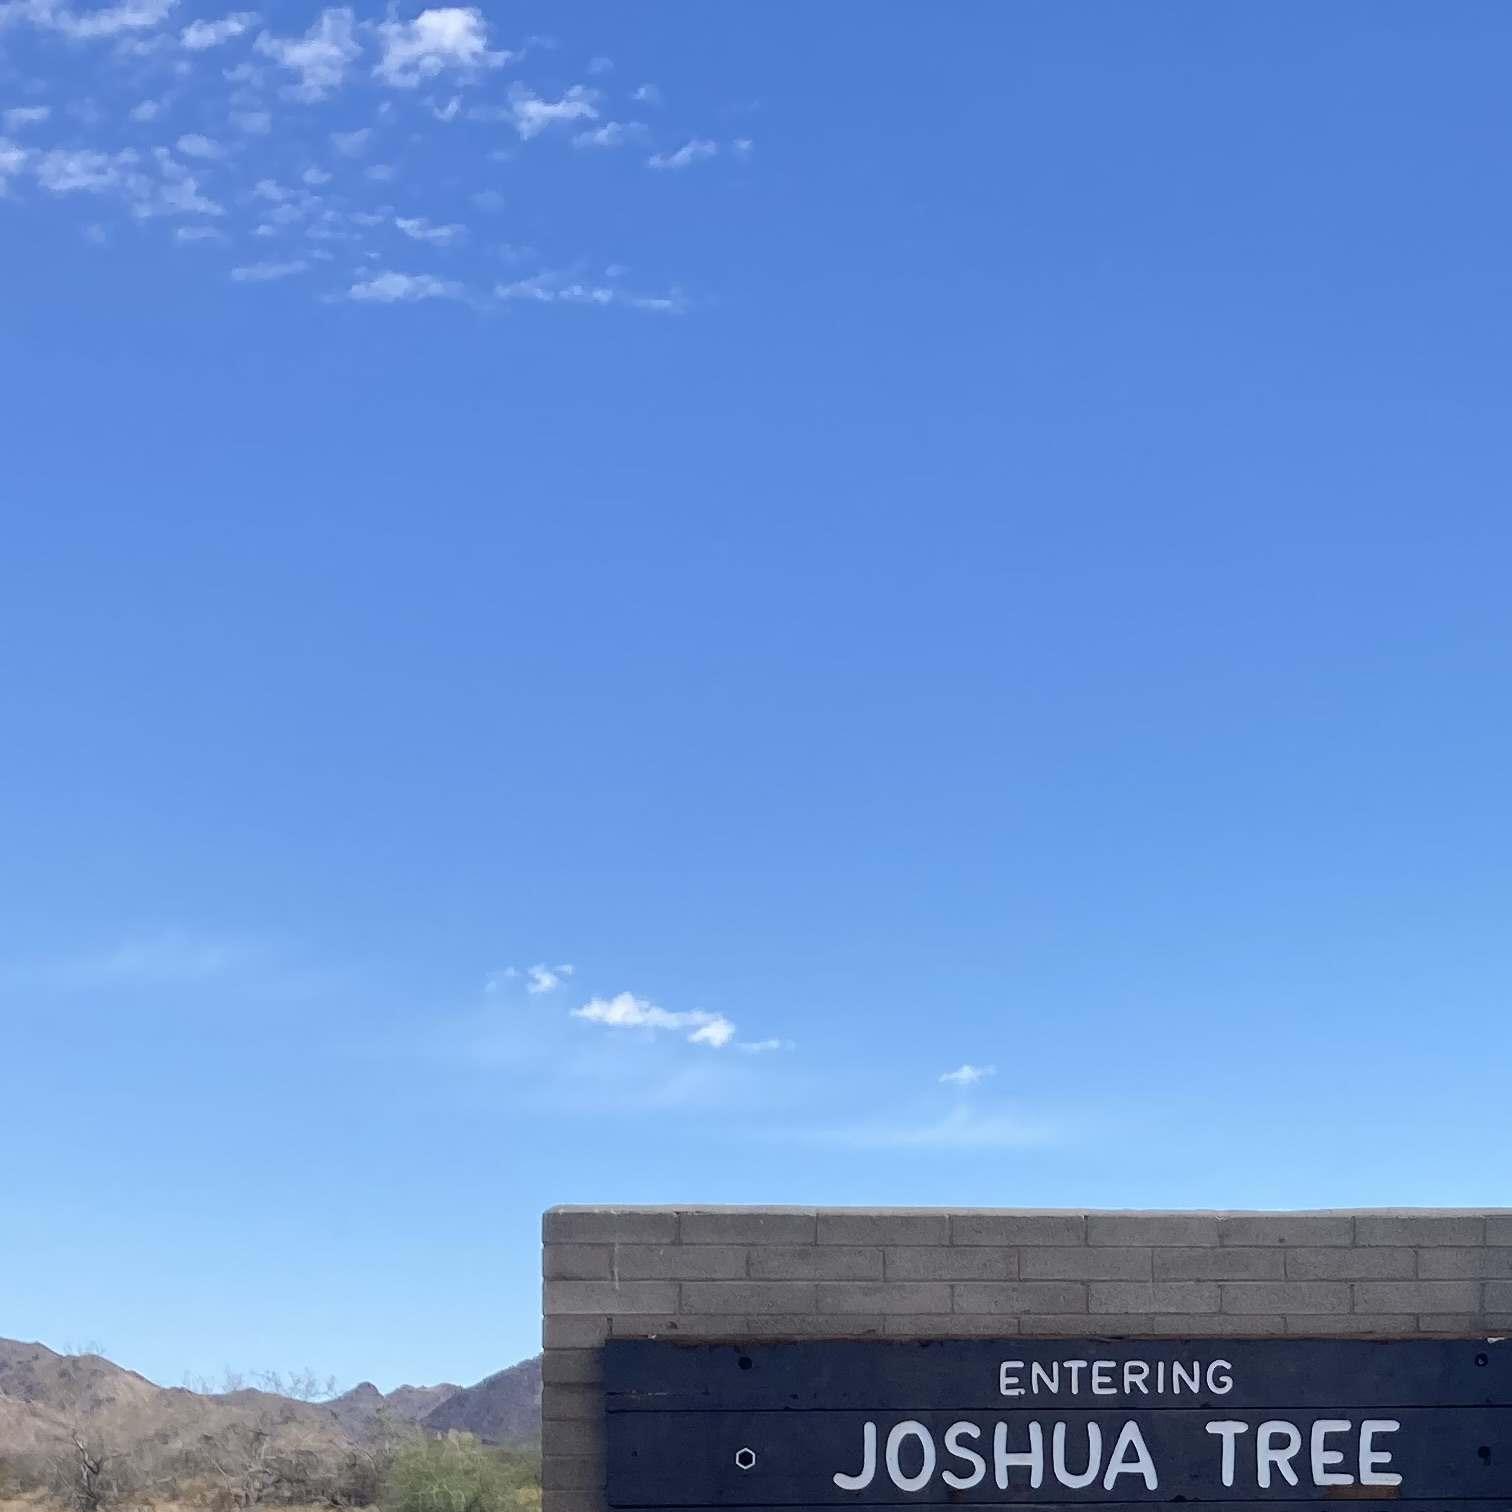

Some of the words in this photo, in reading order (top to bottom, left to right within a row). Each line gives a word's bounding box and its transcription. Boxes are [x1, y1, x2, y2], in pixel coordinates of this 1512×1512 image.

[999, 1359, 1234, 1396] ENTERING
[832, 1420, 1159, 1492] JOSHUA
[1205, 1419, 1403, 1489] TREE
